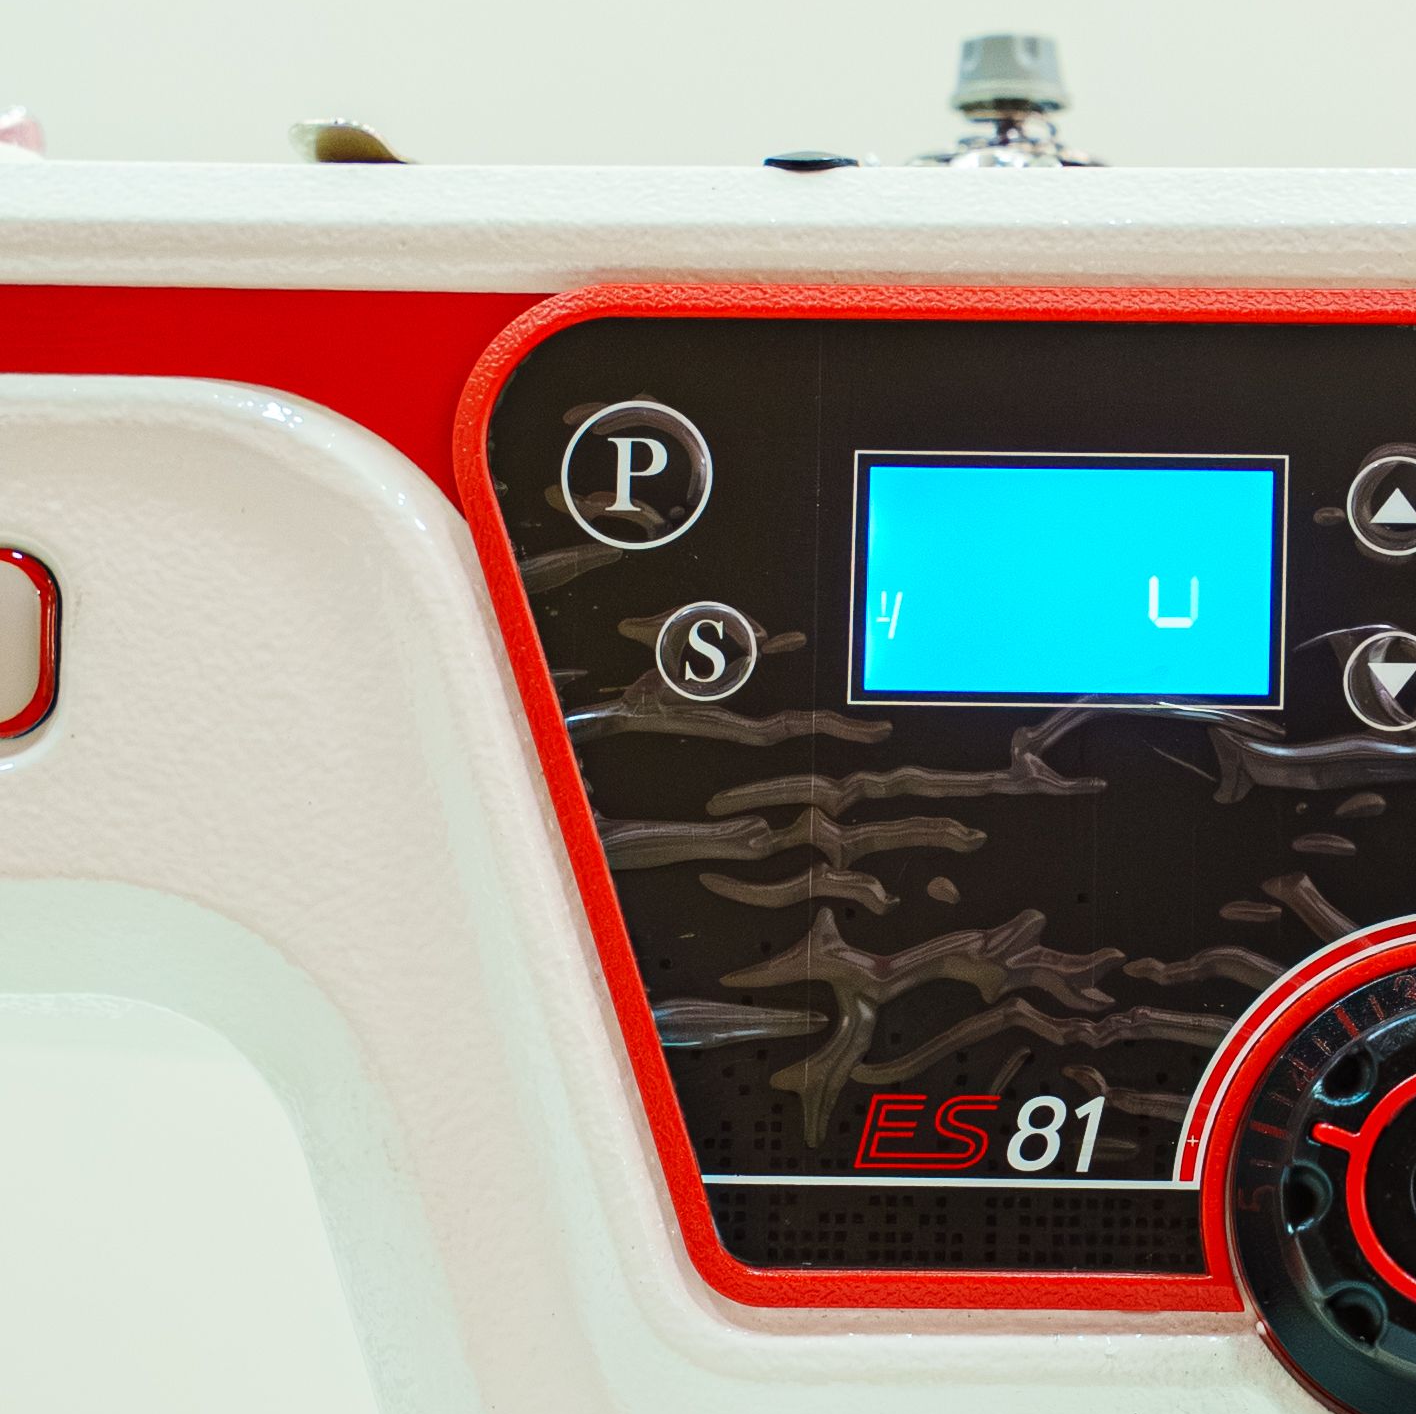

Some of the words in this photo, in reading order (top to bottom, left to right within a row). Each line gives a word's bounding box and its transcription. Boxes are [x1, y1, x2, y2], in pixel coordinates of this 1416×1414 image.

[606, 437, 668, 512] P
[684, 619, 726, 684] S
[853, 1093, 1001, 1170] ES
[1006, 1095, 1105, 1173] 81
